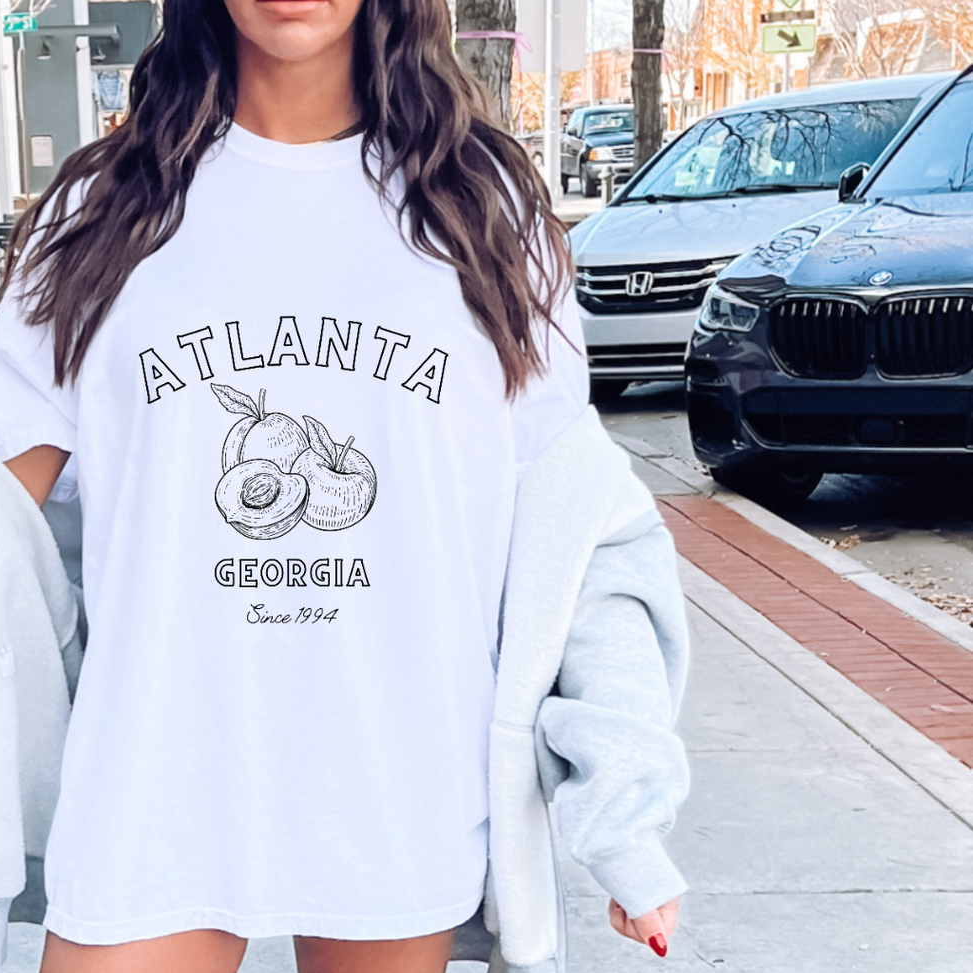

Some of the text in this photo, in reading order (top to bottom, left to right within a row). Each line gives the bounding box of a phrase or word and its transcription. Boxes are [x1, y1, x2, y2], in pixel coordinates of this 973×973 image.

[139, 316, 448, 404] ATLANTA
[214, 558, 371, 588] GEORGIA
[246, 603, 339, 624] Since 1994
